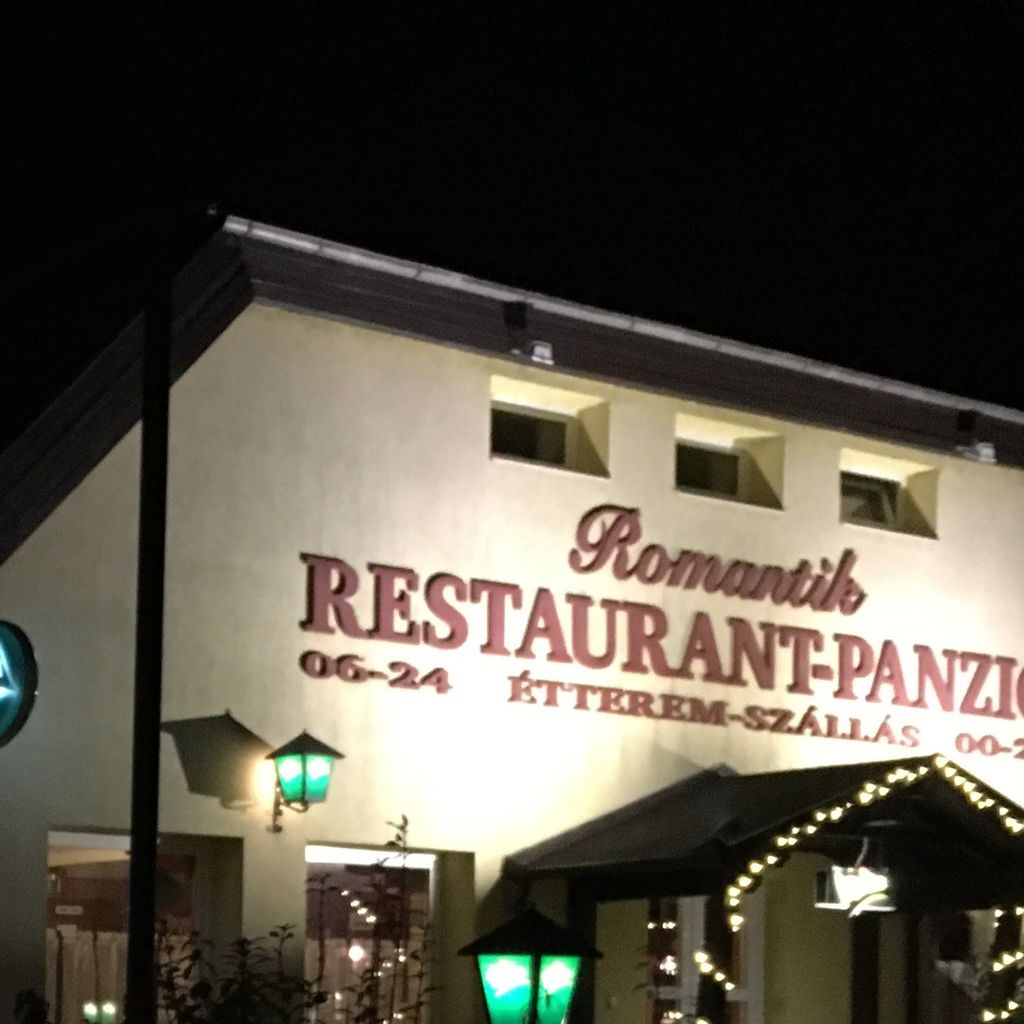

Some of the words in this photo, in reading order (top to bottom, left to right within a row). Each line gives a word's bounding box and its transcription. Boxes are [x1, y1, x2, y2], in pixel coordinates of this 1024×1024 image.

[568, 503, 867, 615] Romantik
[298, 552, 1024, 724] RESTAURANT-PANZI
[298, 650, 453, 695] 06-24
[507, 670, 921, 748] ÉTTEREM-SZÁLLÁS
